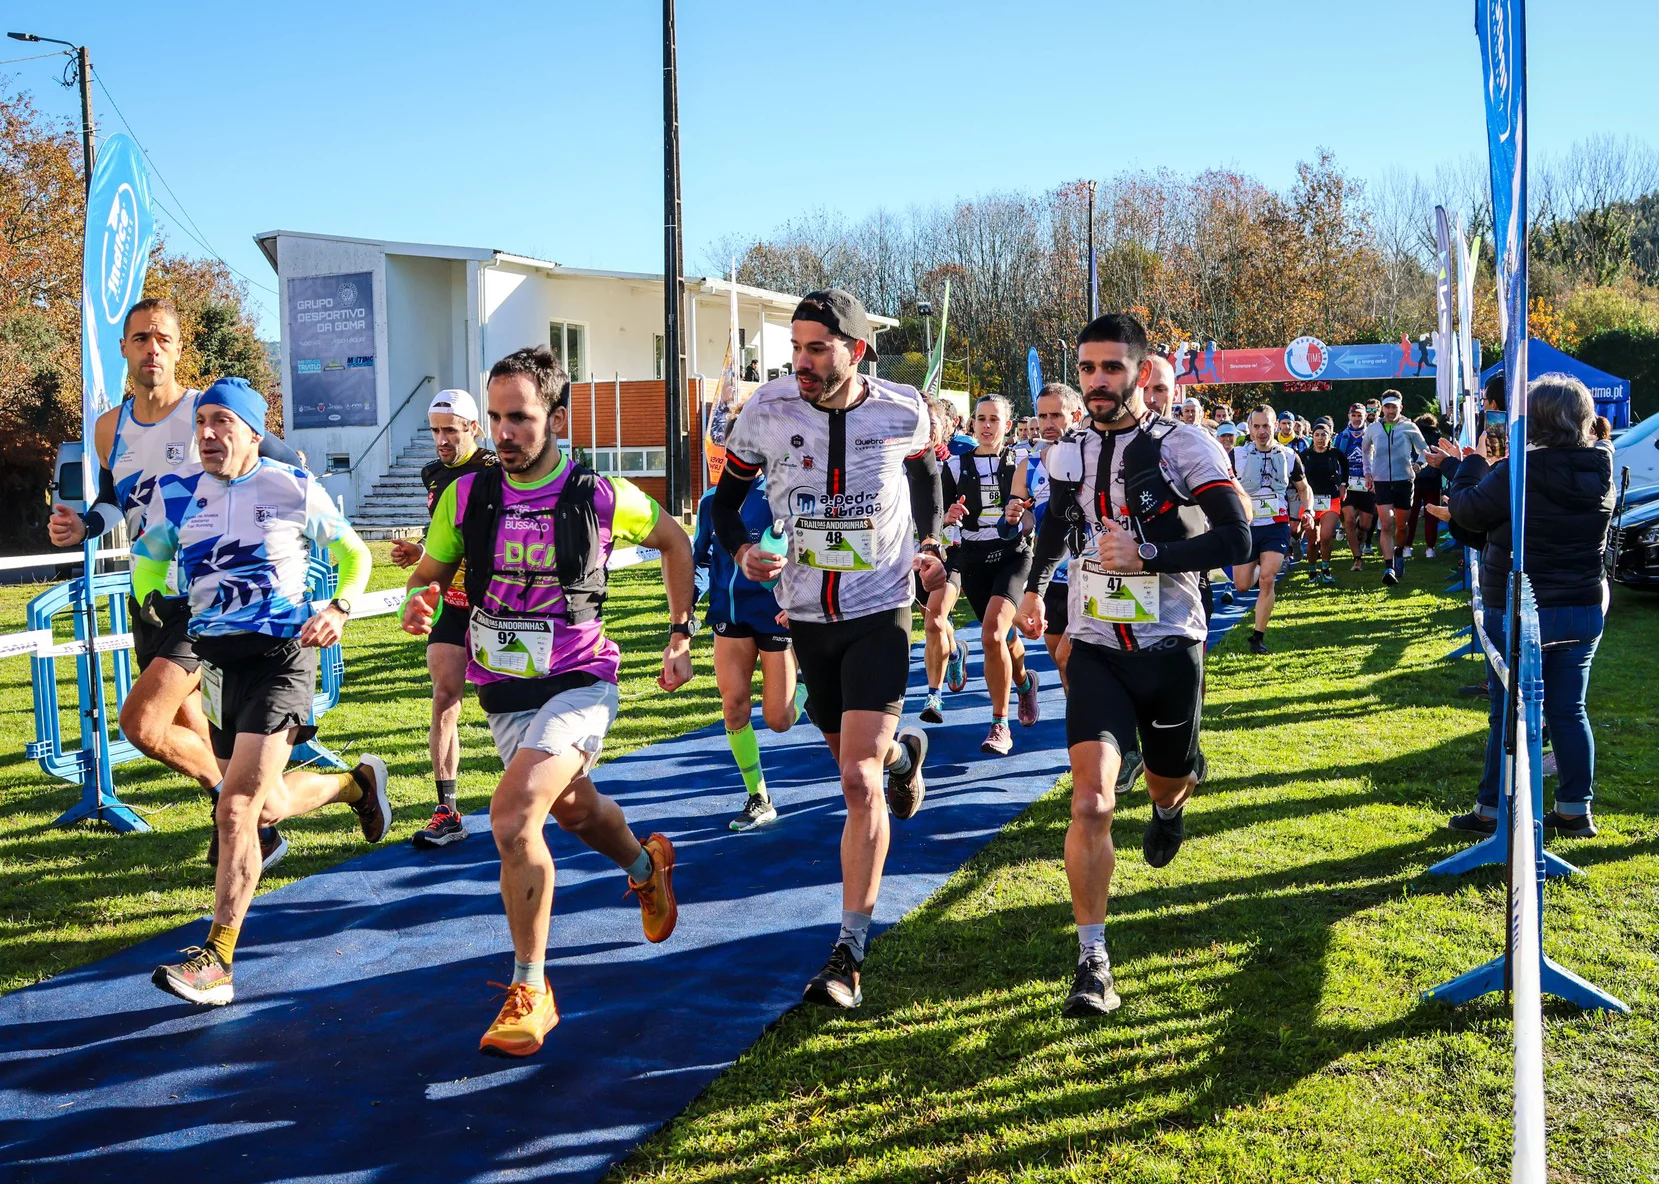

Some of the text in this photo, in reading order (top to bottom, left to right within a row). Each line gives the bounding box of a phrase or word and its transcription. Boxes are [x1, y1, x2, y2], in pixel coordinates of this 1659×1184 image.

[297, 298, 333, 310] GRUPO
[297, 308, 365, 322] DESPORTIVO
[317, 320, 365, 332] DA GOMA
[989, 491, 999, 500] 68
[839, 502, 882, 517] braga
[800, 520, 818, 529] TRAIL
[826, 520, 869, 530] ANDORINHAS
[825, 531, 843, 544] 48
[1107, 577, 1123, 591] 47
[497, 620, 545, 631] ANDORINHAS
[497, 631, 517, 645] 92
